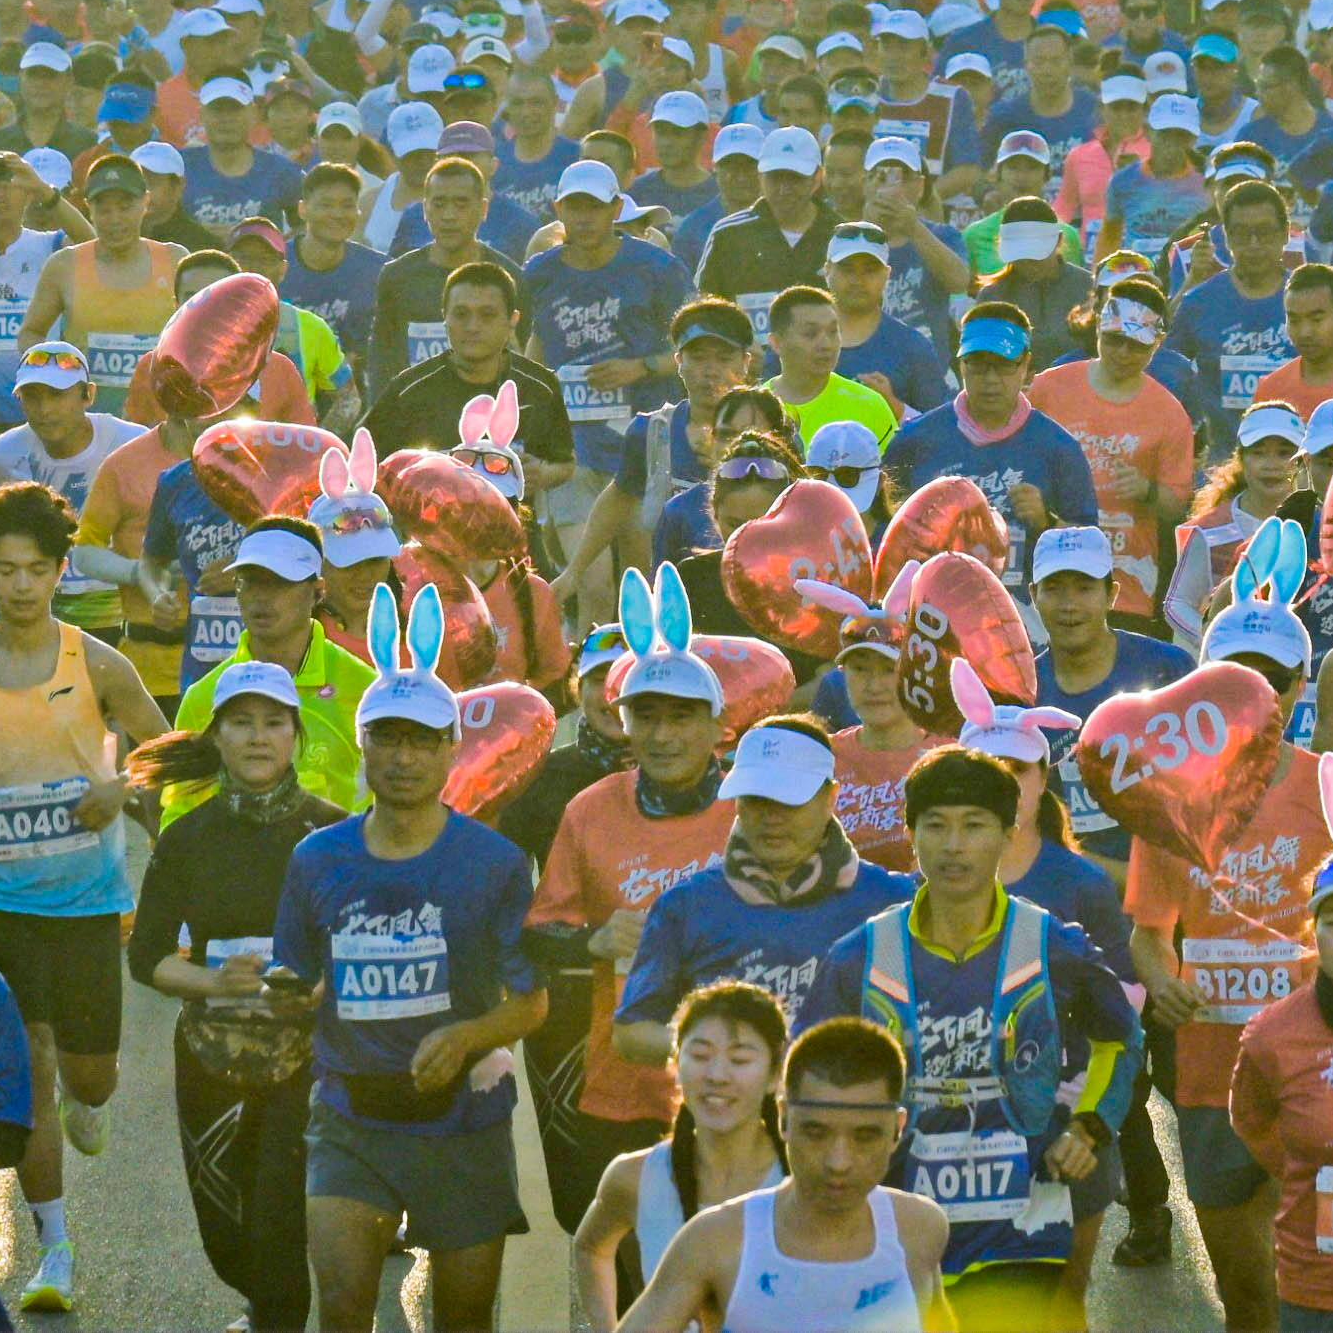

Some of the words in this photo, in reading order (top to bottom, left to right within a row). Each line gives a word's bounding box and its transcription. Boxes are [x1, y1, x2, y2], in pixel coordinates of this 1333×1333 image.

[907, 604, 949, 714] 5:30
[1100, 699, 1227, 794] 2:30
[342, 961, 438, 997] A0147
[1194, 967, 1291, 1000] B1208
[912, 1161, 1013, 1202] A0117
